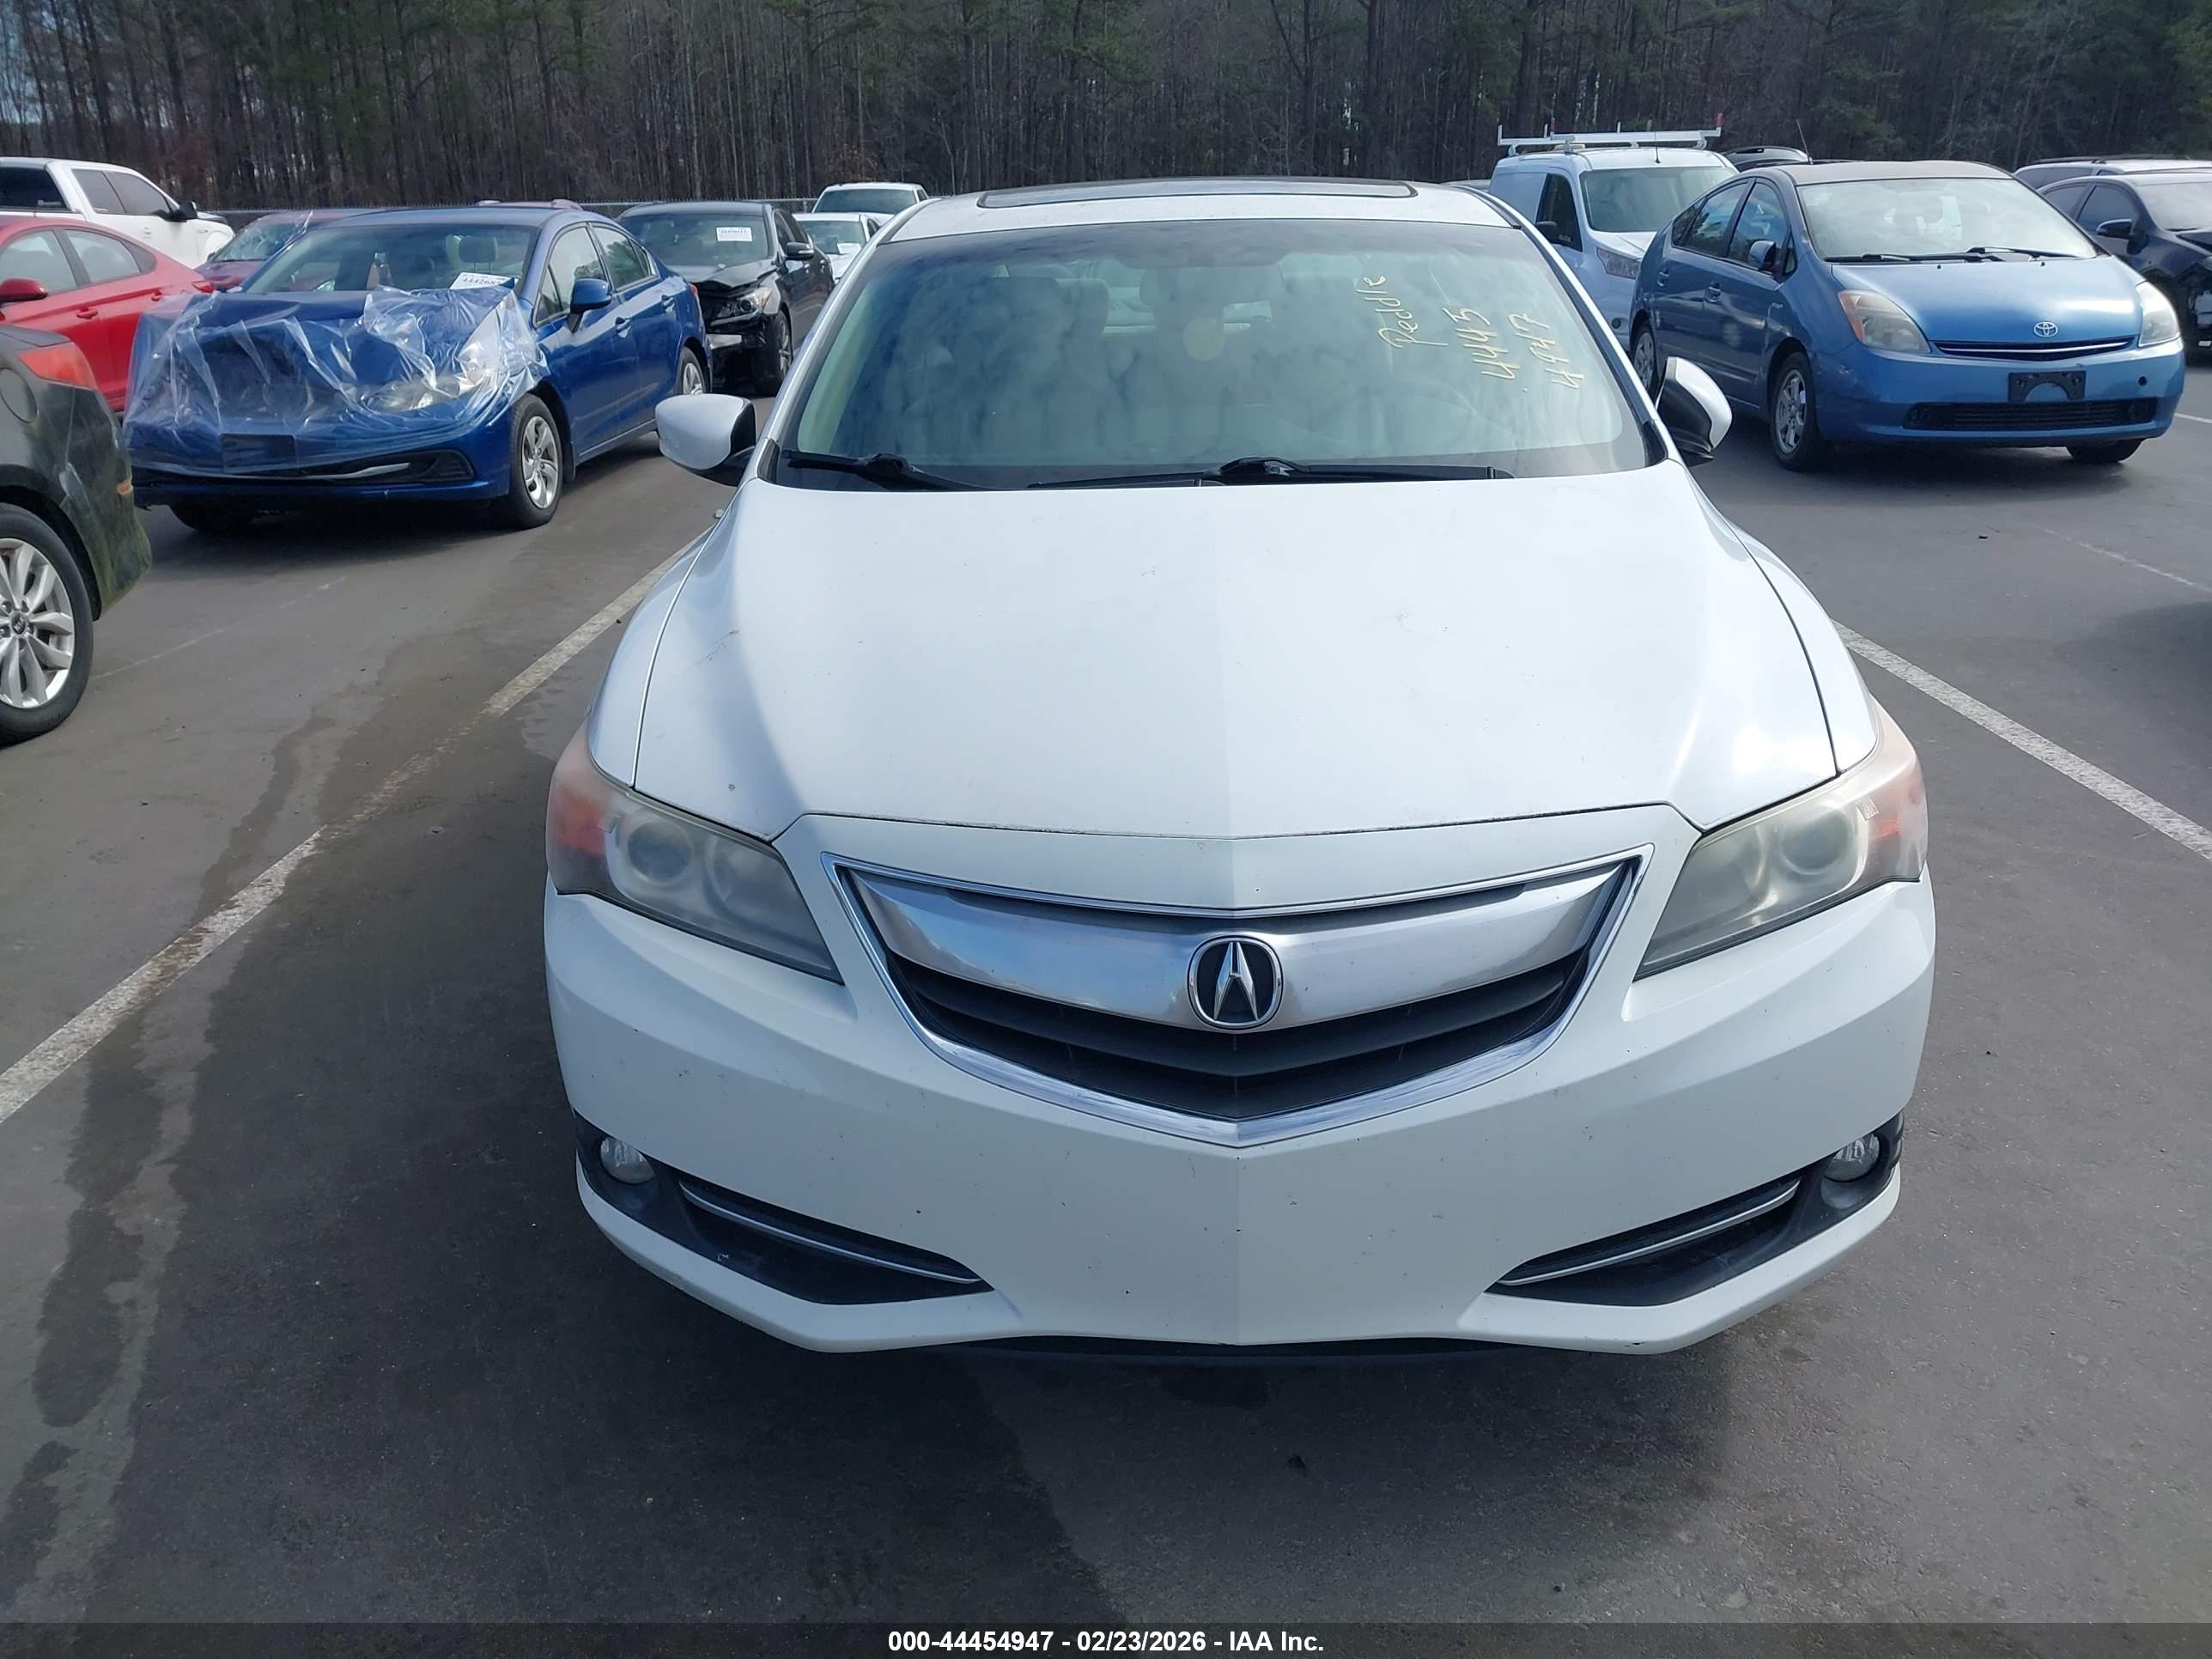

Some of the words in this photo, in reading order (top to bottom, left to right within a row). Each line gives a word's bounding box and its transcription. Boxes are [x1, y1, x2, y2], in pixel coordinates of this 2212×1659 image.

[1356, 275, 1449, 348] Peddle
[1442, 307, 1521, 380] 4445
[1508, 313, 1585, 389] 4947
